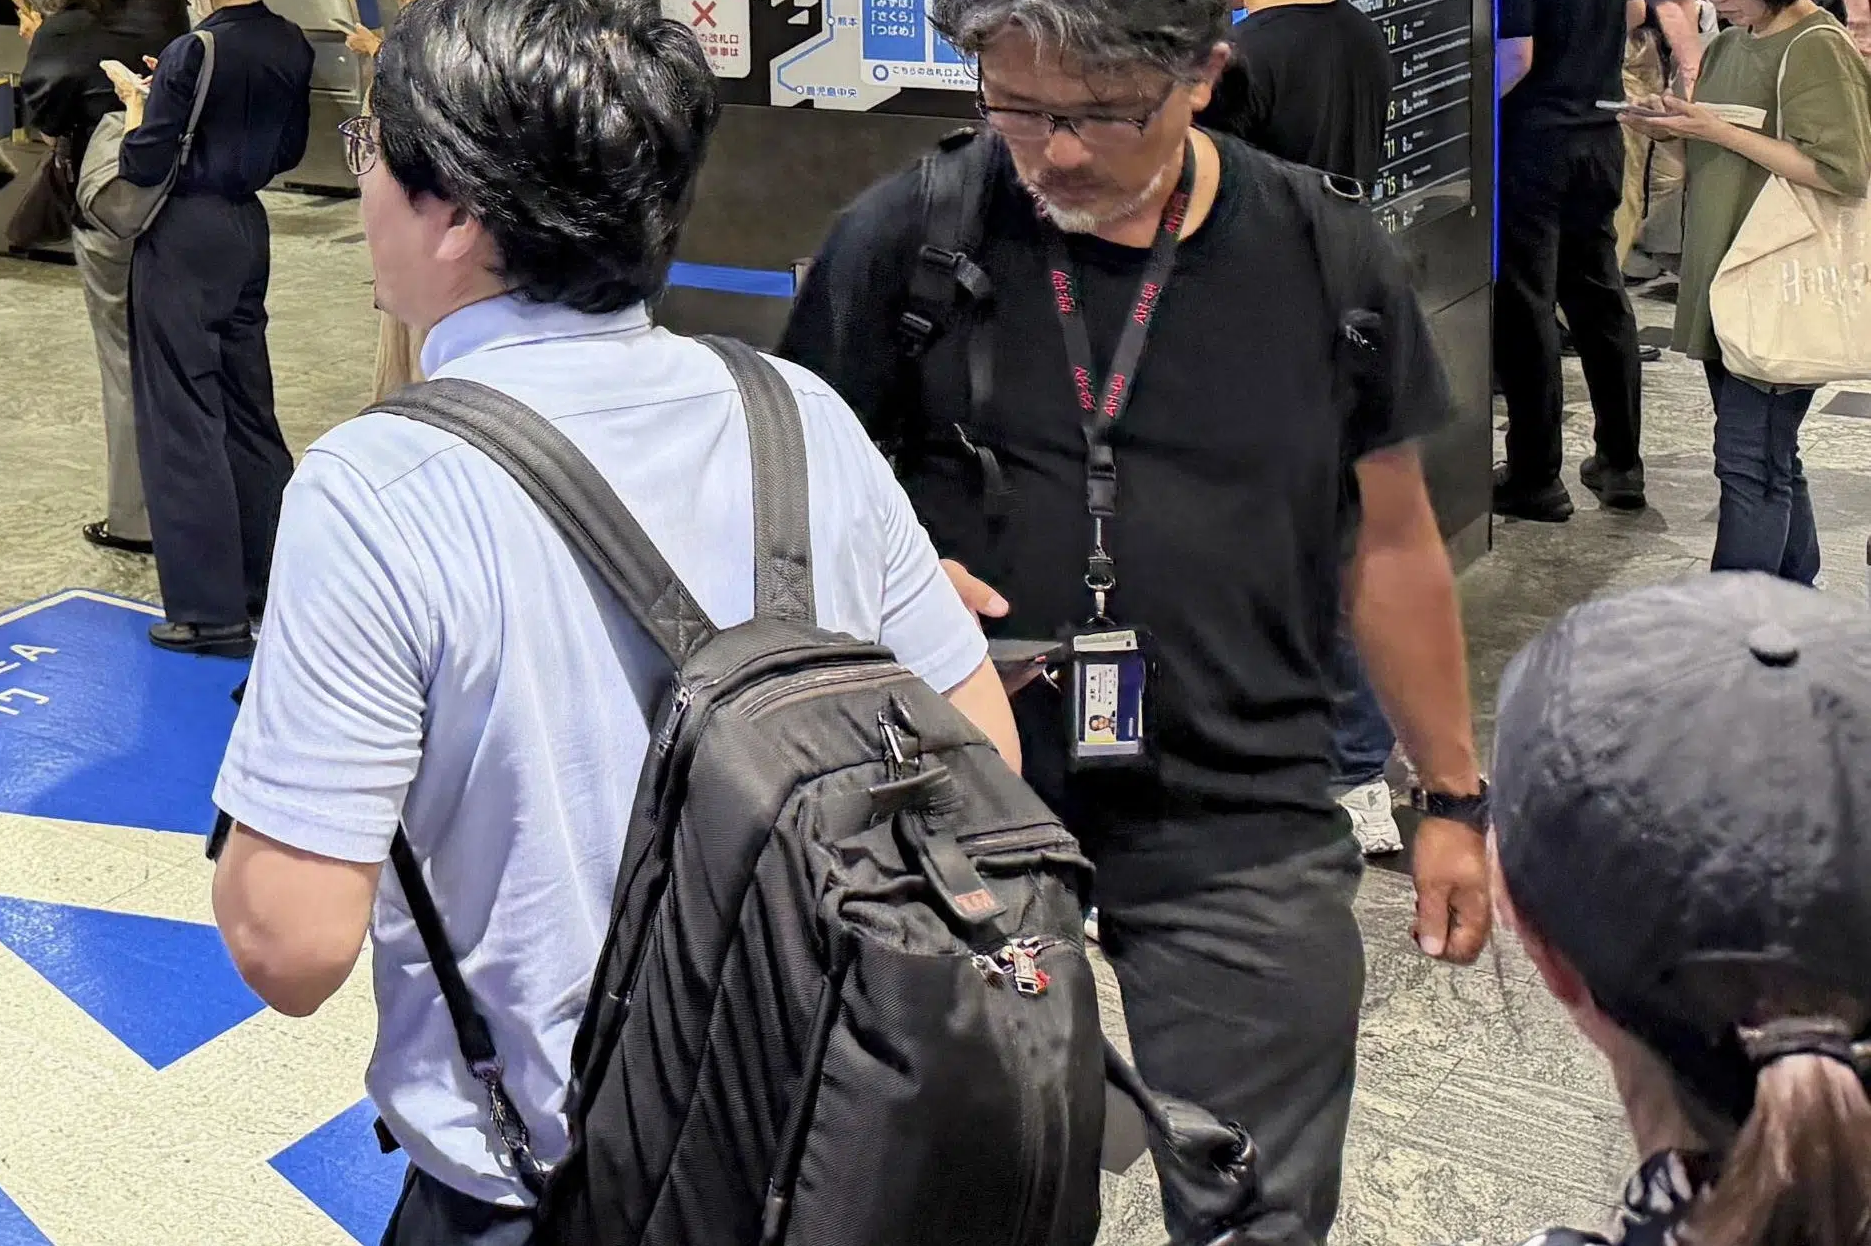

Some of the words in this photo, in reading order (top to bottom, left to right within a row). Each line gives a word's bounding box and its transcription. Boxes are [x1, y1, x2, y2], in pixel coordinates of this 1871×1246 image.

[871, 10, 914, 24] 「さくら」
[871, 24, 915, 38] 「つばめ」
[8, 641, 60, 662] A
